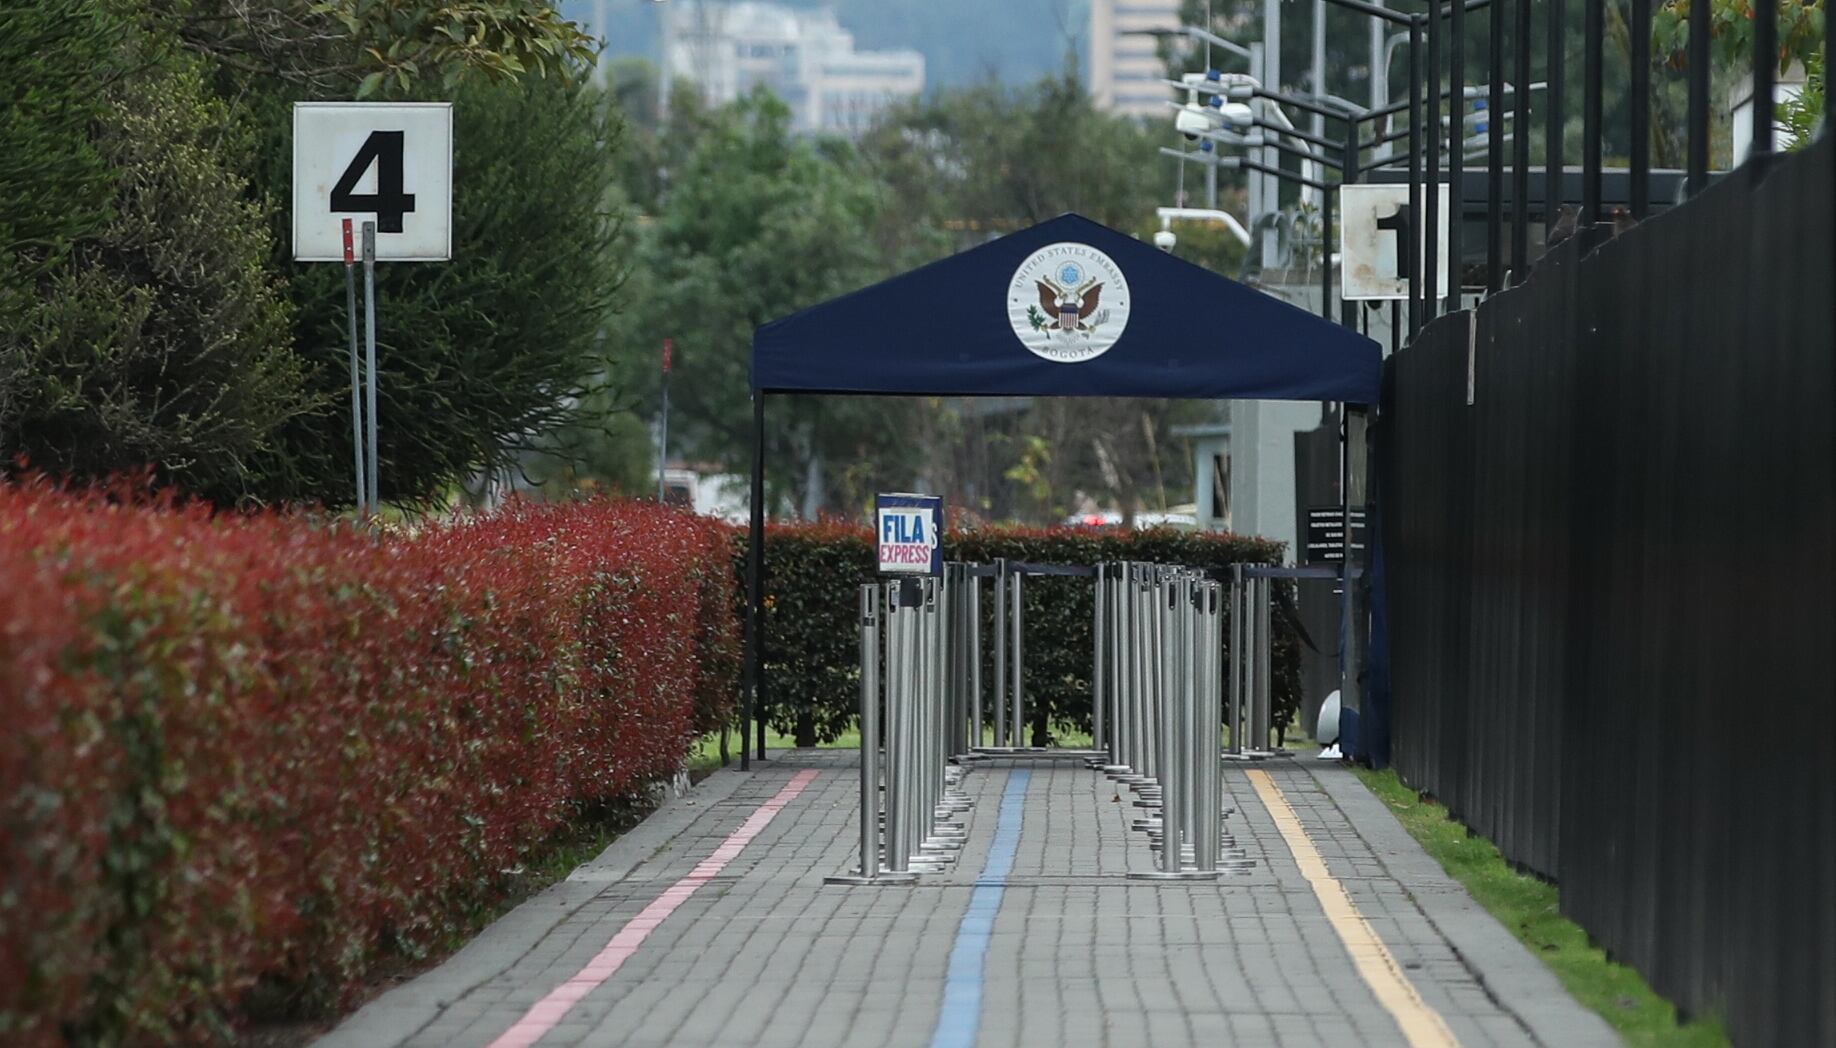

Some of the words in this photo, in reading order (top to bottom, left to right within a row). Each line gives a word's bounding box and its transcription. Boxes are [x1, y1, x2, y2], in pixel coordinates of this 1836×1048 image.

[330, 130, 415, 233] 4
[1377, 204, 1410, 279] 1
[1015, 254, 1045, 288] UNITED
[1048, 247, 1086, 258] STATES
[1090, 253, 1123, 291] EMBASSY
[883, 515, 924, 542] FILA
[880, 545, 929, 563] EXPRESS
